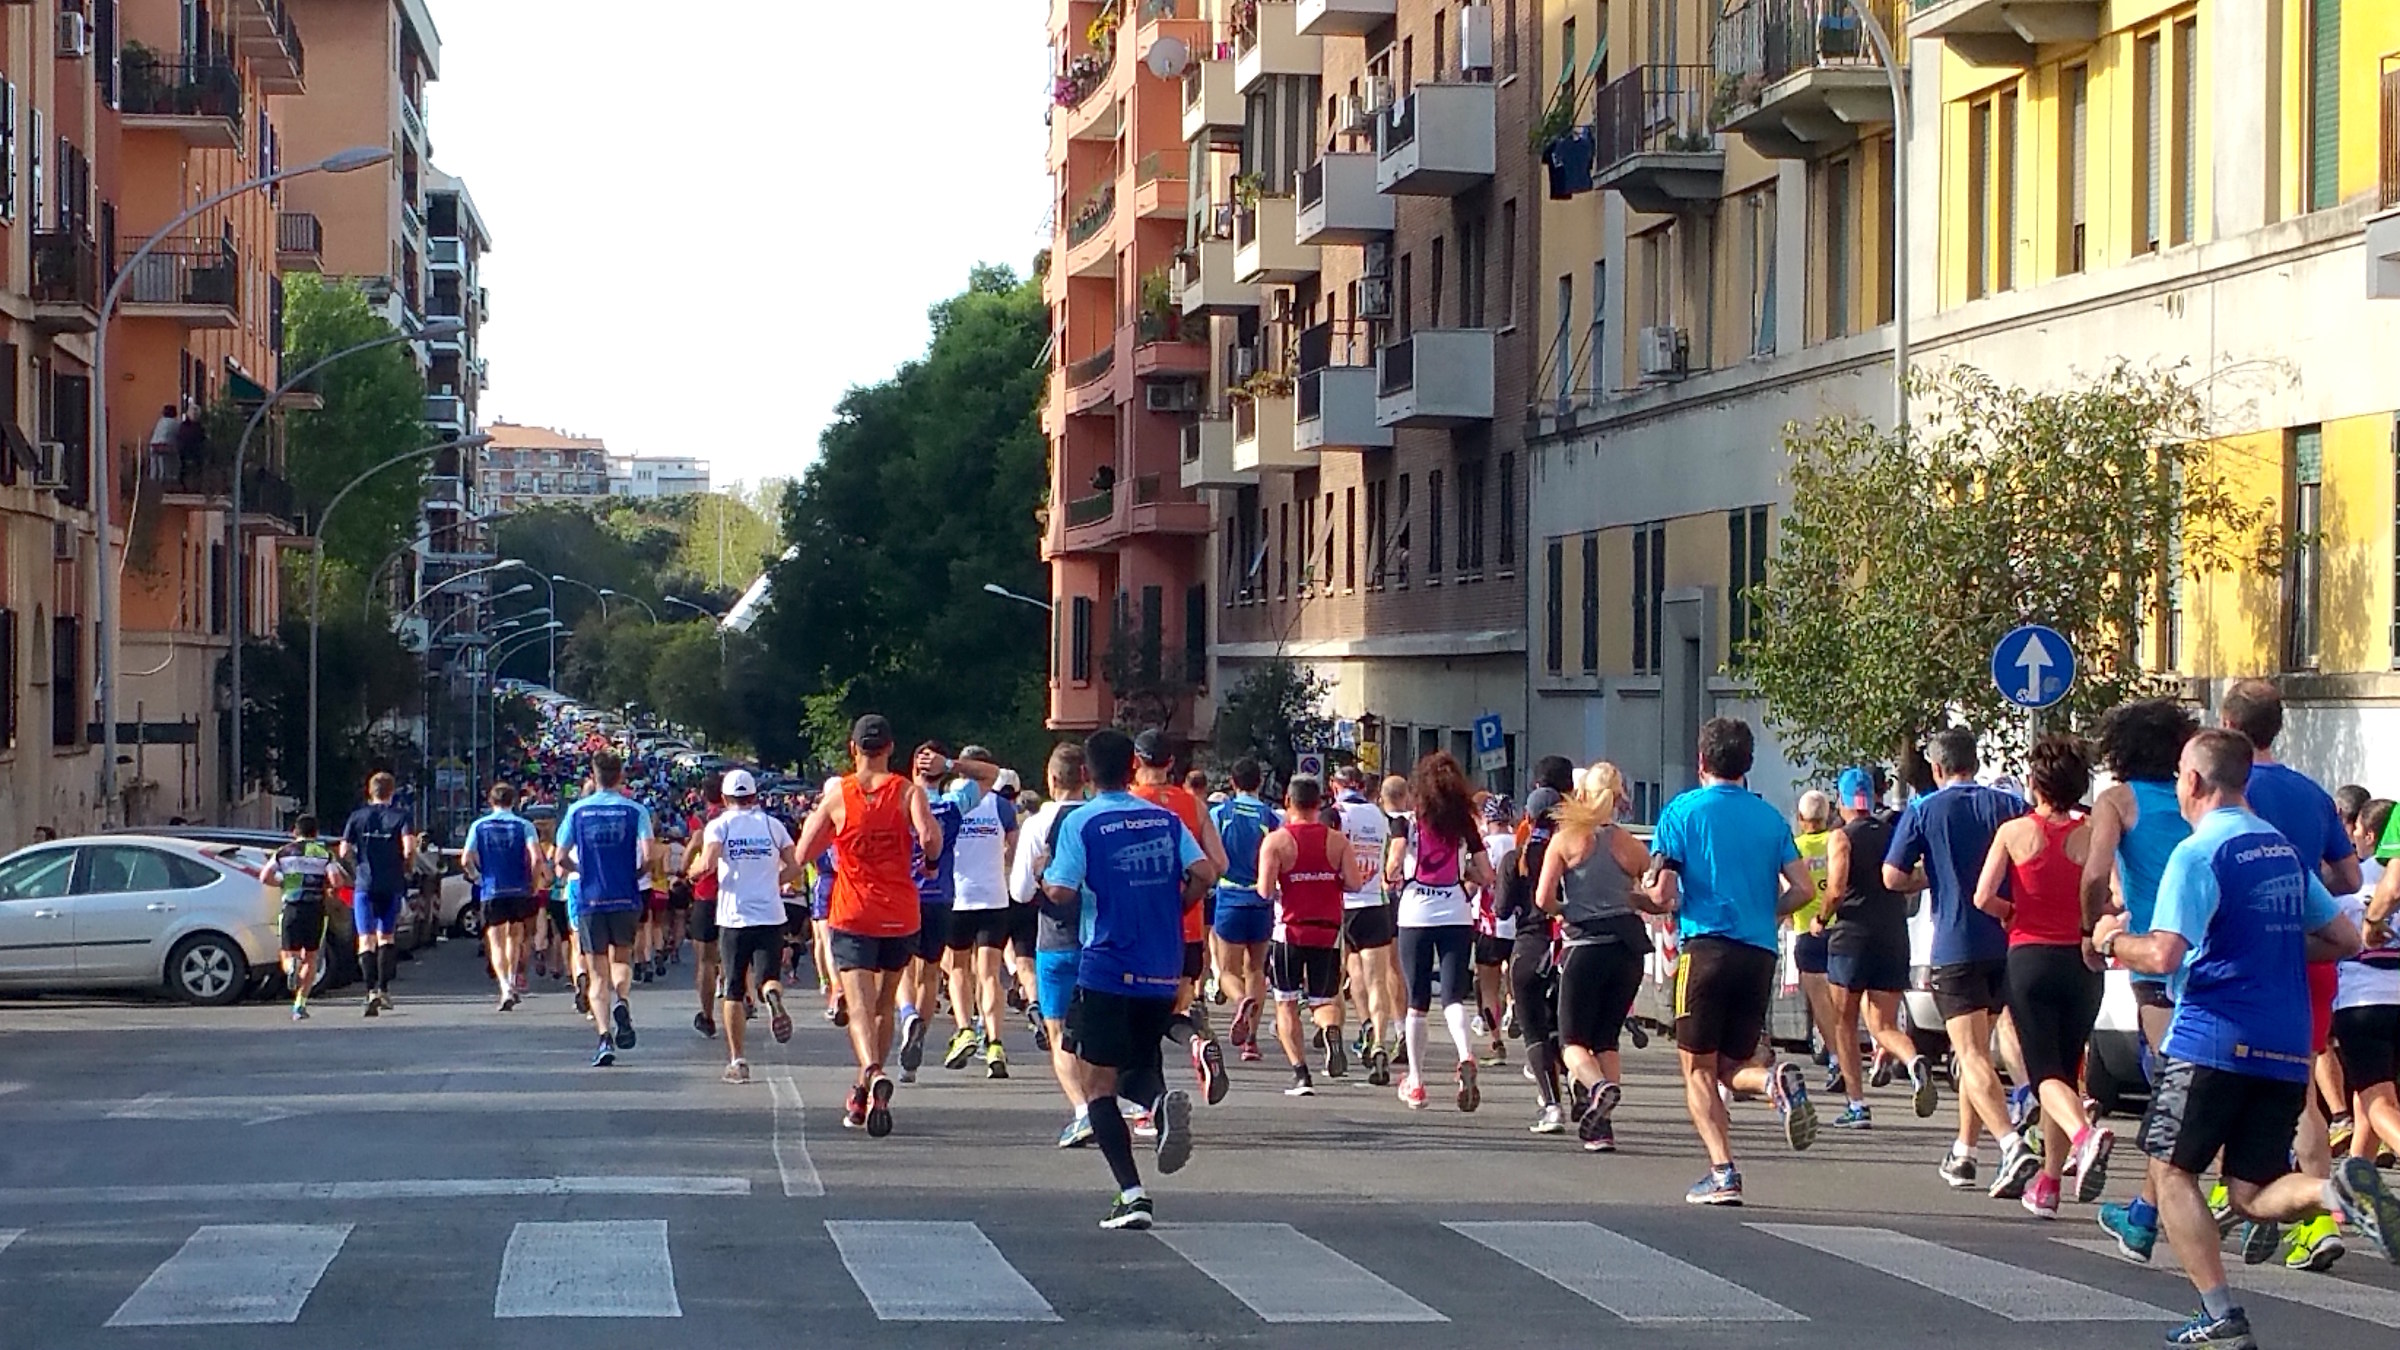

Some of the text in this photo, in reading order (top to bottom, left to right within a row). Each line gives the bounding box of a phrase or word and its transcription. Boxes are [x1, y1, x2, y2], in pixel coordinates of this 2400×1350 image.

[1481, 721, 1497, 748] P
[1100, 821, 1124, 835] new
[2235, 847, 2263, 865] new
